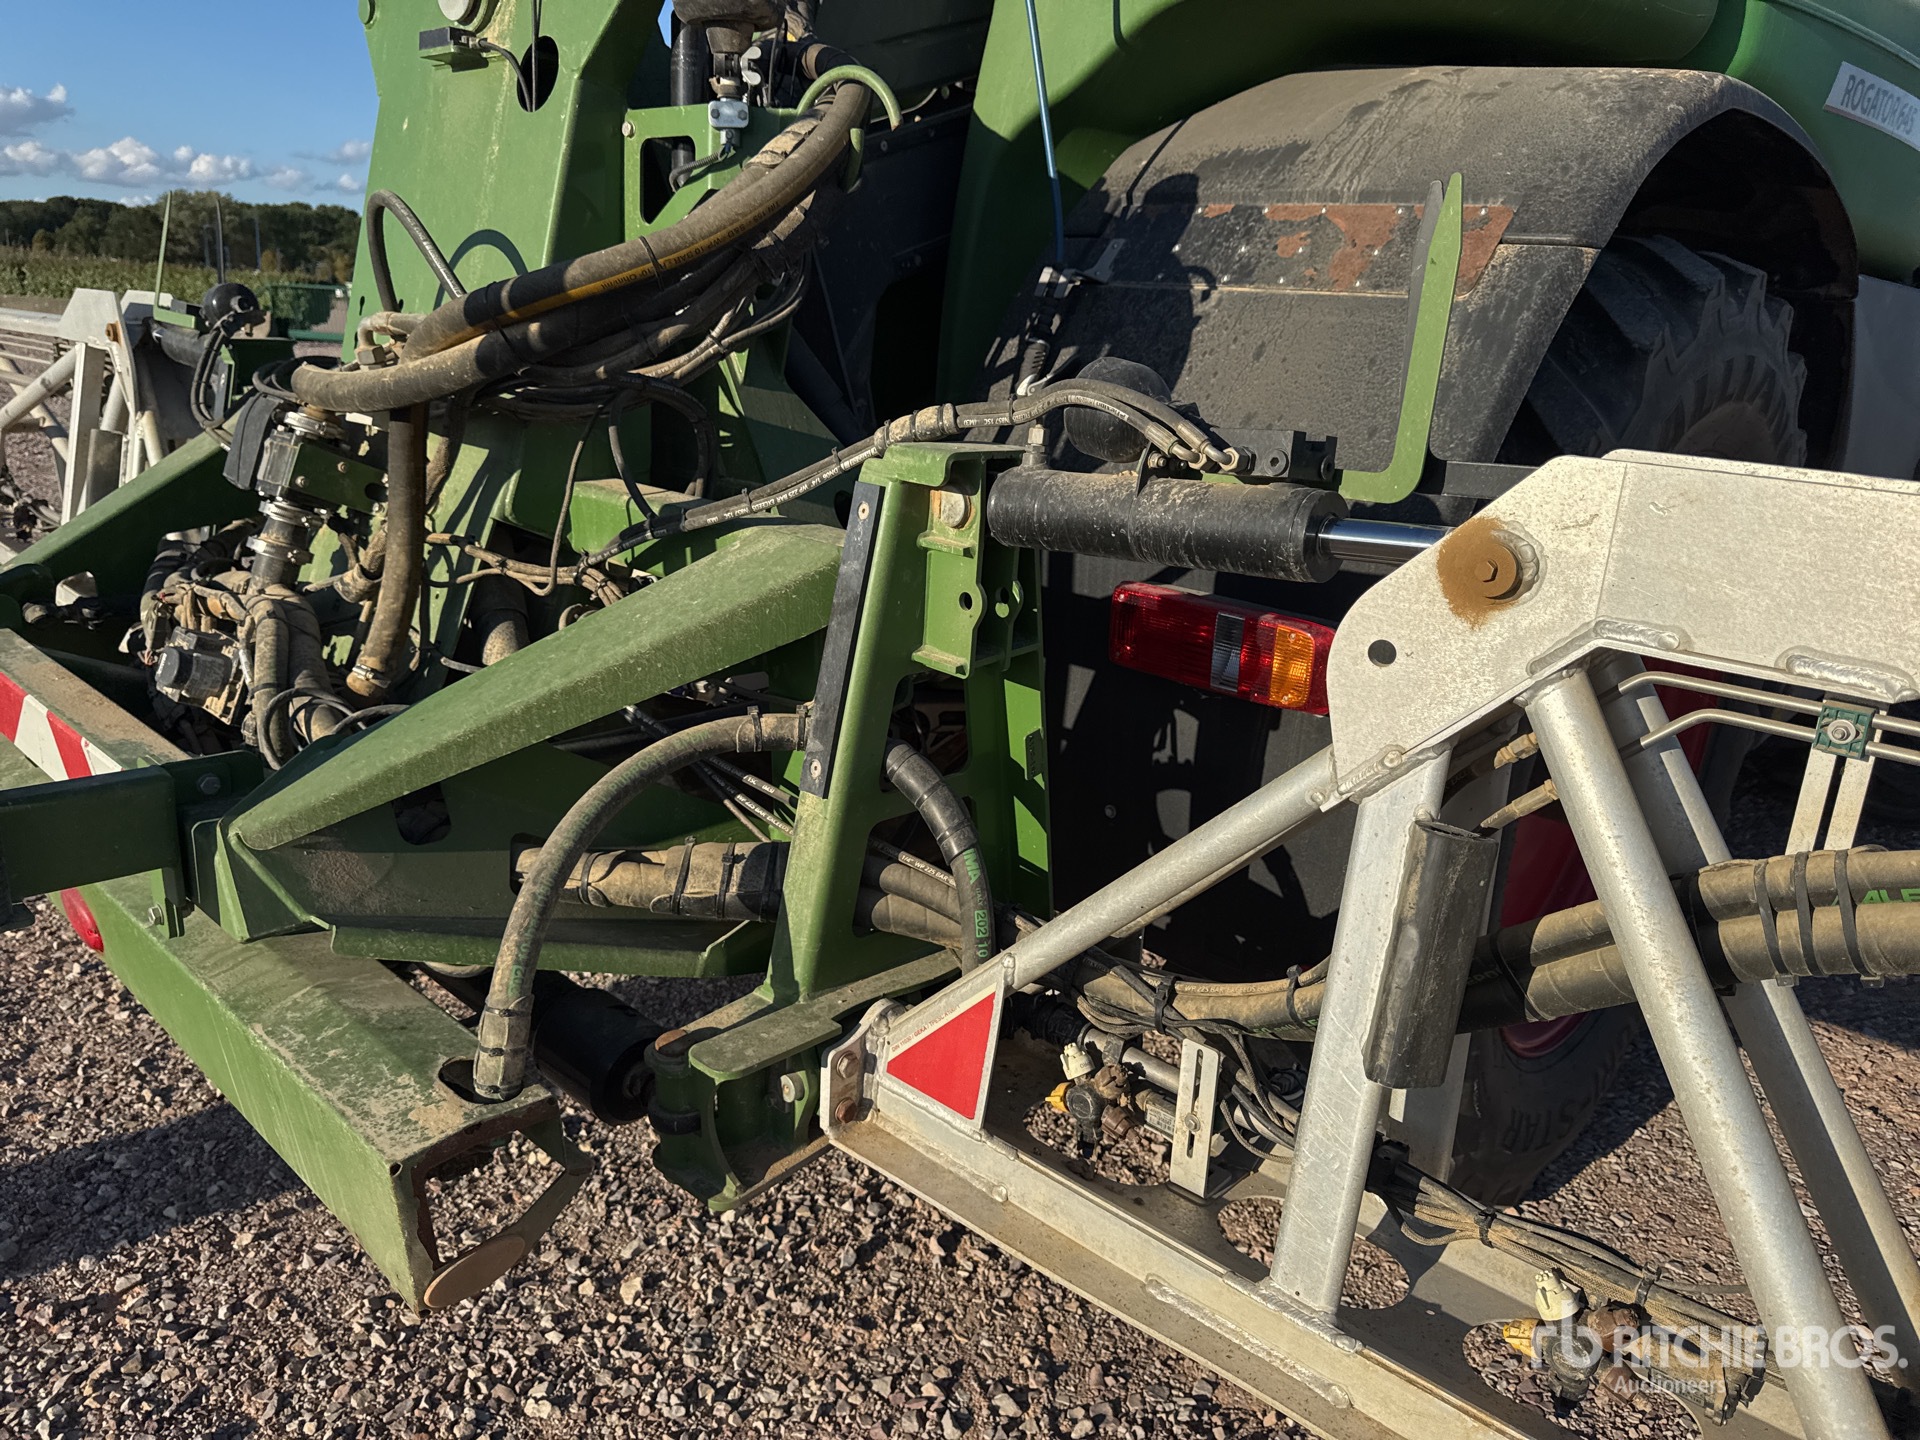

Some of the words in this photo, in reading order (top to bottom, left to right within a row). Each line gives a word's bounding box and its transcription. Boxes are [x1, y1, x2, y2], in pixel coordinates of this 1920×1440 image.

[1840, 74, 1901, 126] ROGATOR
[924, 866, 936, 876] 225
[935, 871, 949, 882] BAR
[976, 911, 987, 937] 202
[914, 1026, 928, 1037] GEKA
